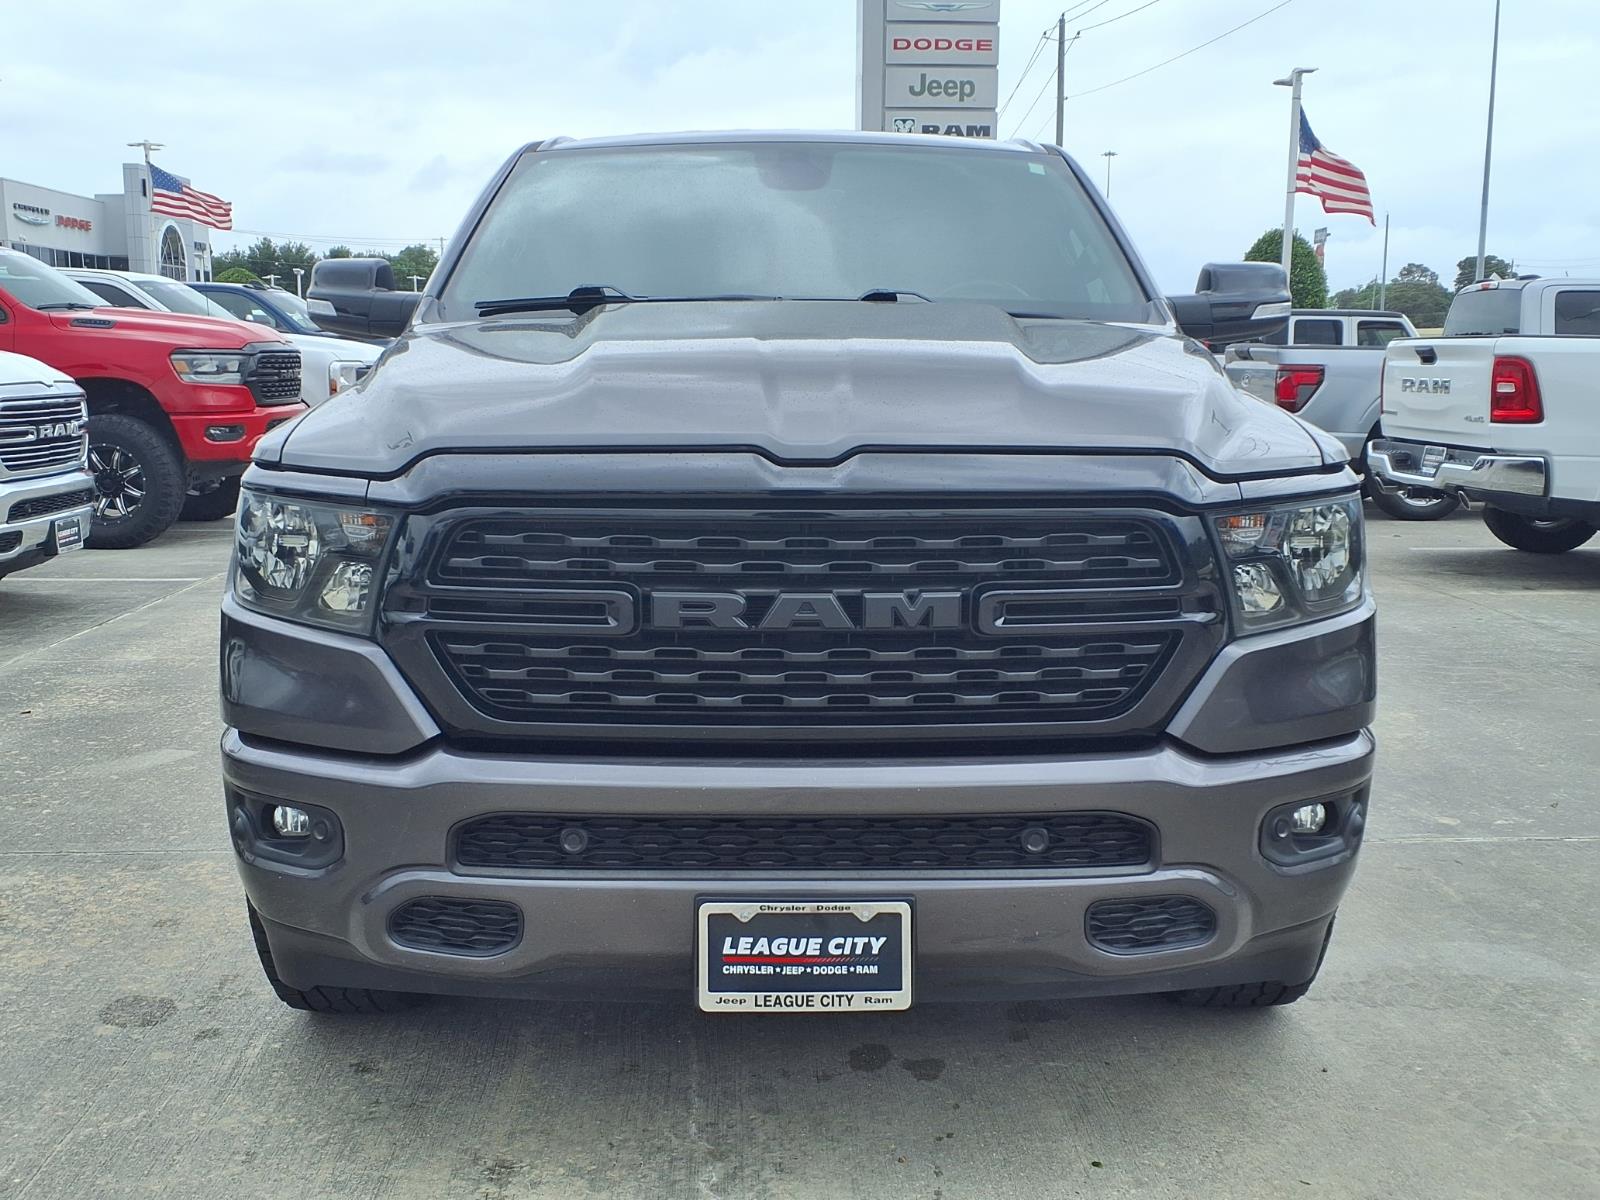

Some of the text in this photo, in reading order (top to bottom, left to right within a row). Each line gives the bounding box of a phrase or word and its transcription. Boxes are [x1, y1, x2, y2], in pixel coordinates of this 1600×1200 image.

[893, 38, 992, 51] DODGE
[908, 73, 976, 102] Jeep
[921, 125, 991, 137] RAM
[1401, 378, 1451, 394] RAM
[39, 422, 79, 438] RAM
[650, 591, 962, 629] RAM
[759, 904, 851, 912] Chrysler Dodge
[722, 936, 887, 956] LEAGUE CITY
[722, 965, 878, 975] CHRYSLER JEEP DODGE RAM
[715, 994, 893, 1008] Jeep LEAGUE CITY Ram
